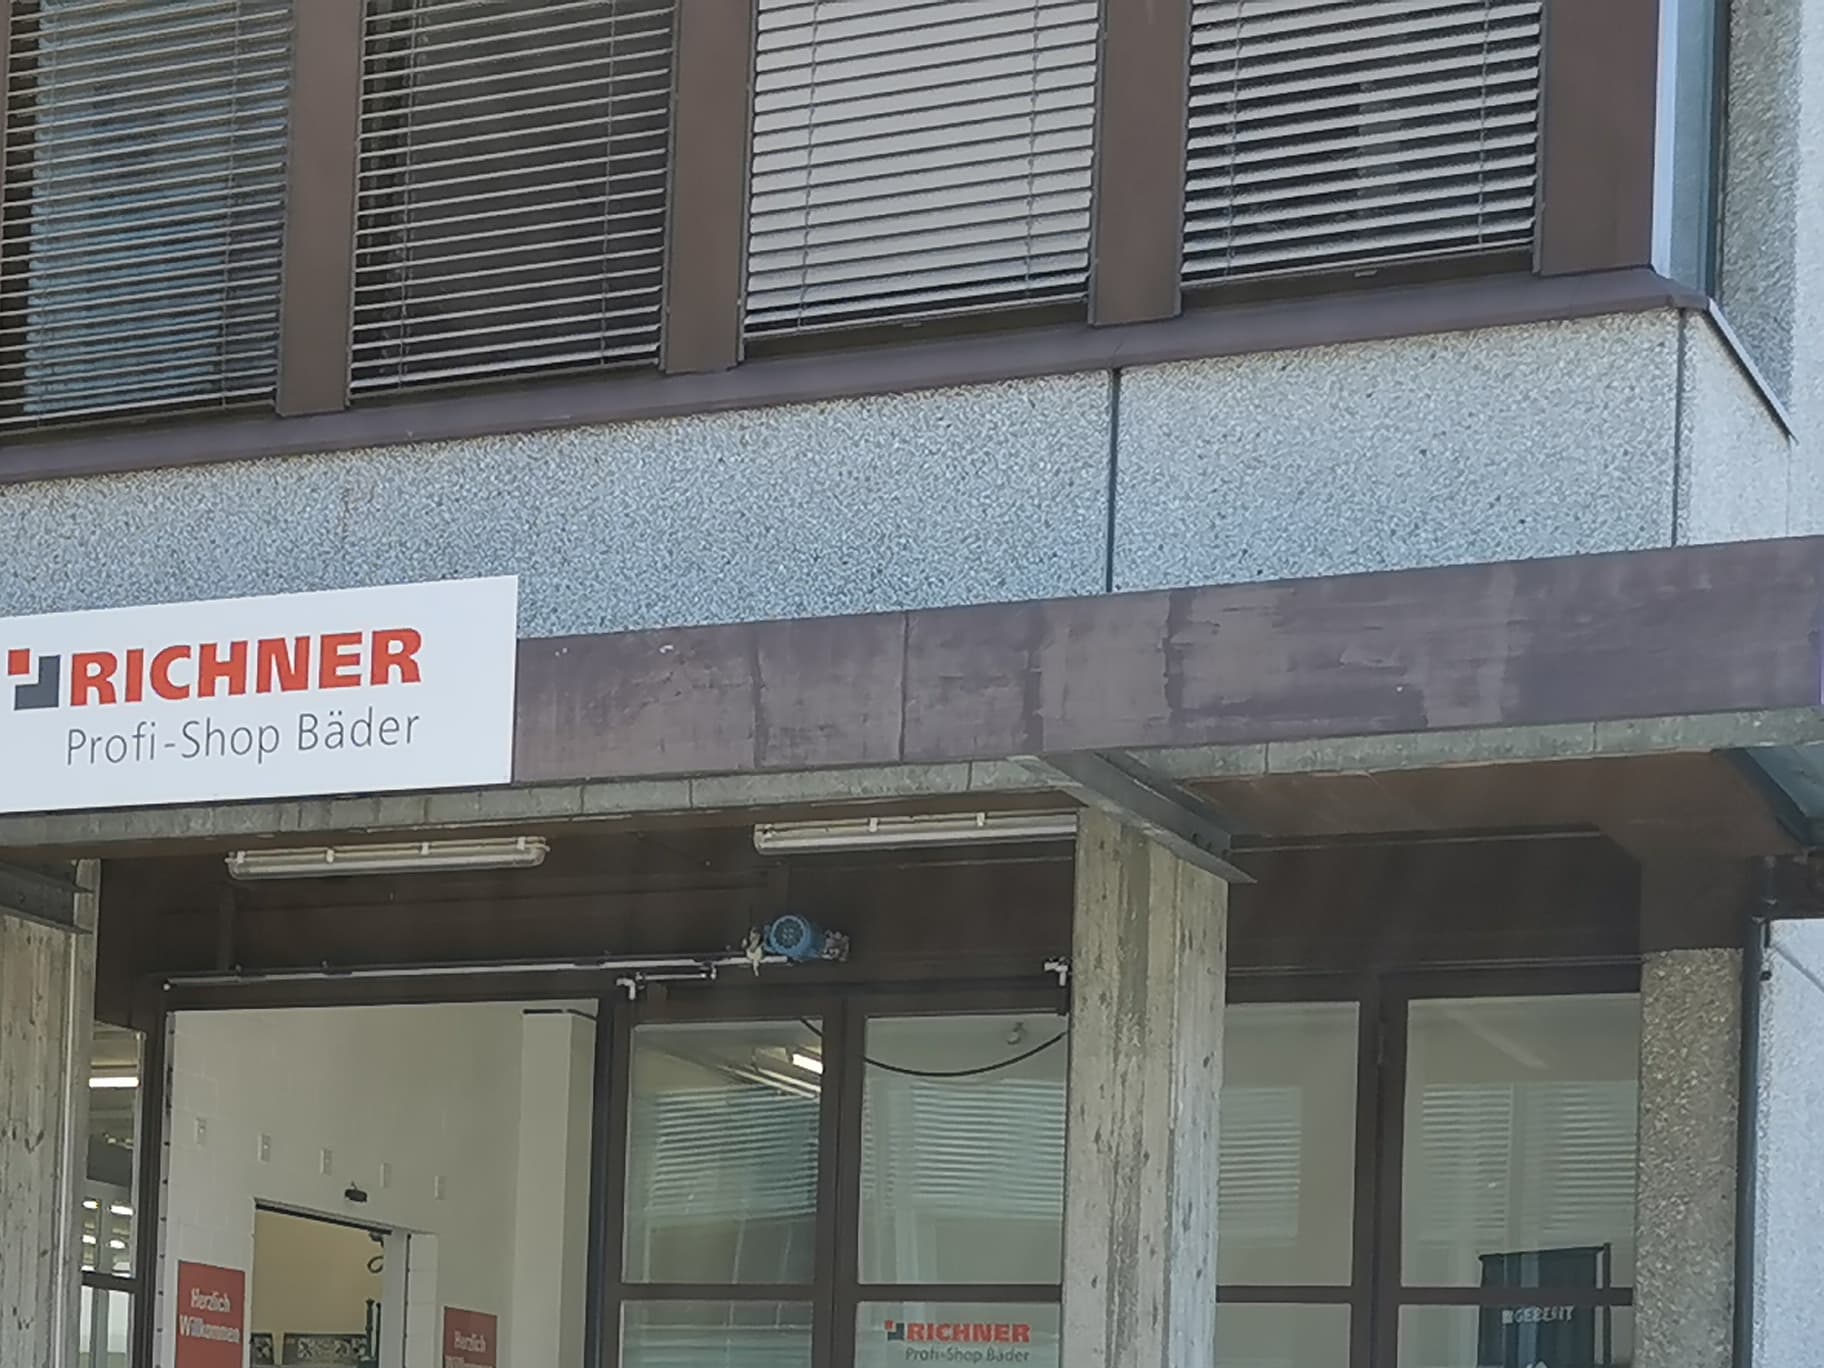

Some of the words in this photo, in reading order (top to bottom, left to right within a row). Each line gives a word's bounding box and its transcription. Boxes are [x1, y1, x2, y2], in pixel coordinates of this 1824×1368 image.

[70, 627, 422, 707] RICHNER
[66, 716, 280, 766] Profi-Shop
[297, 706, 421, 752] Bäder
[191, 1288, 231, 1312] Herzlich
[907, 1322, 1031, 1343] RICHNER
